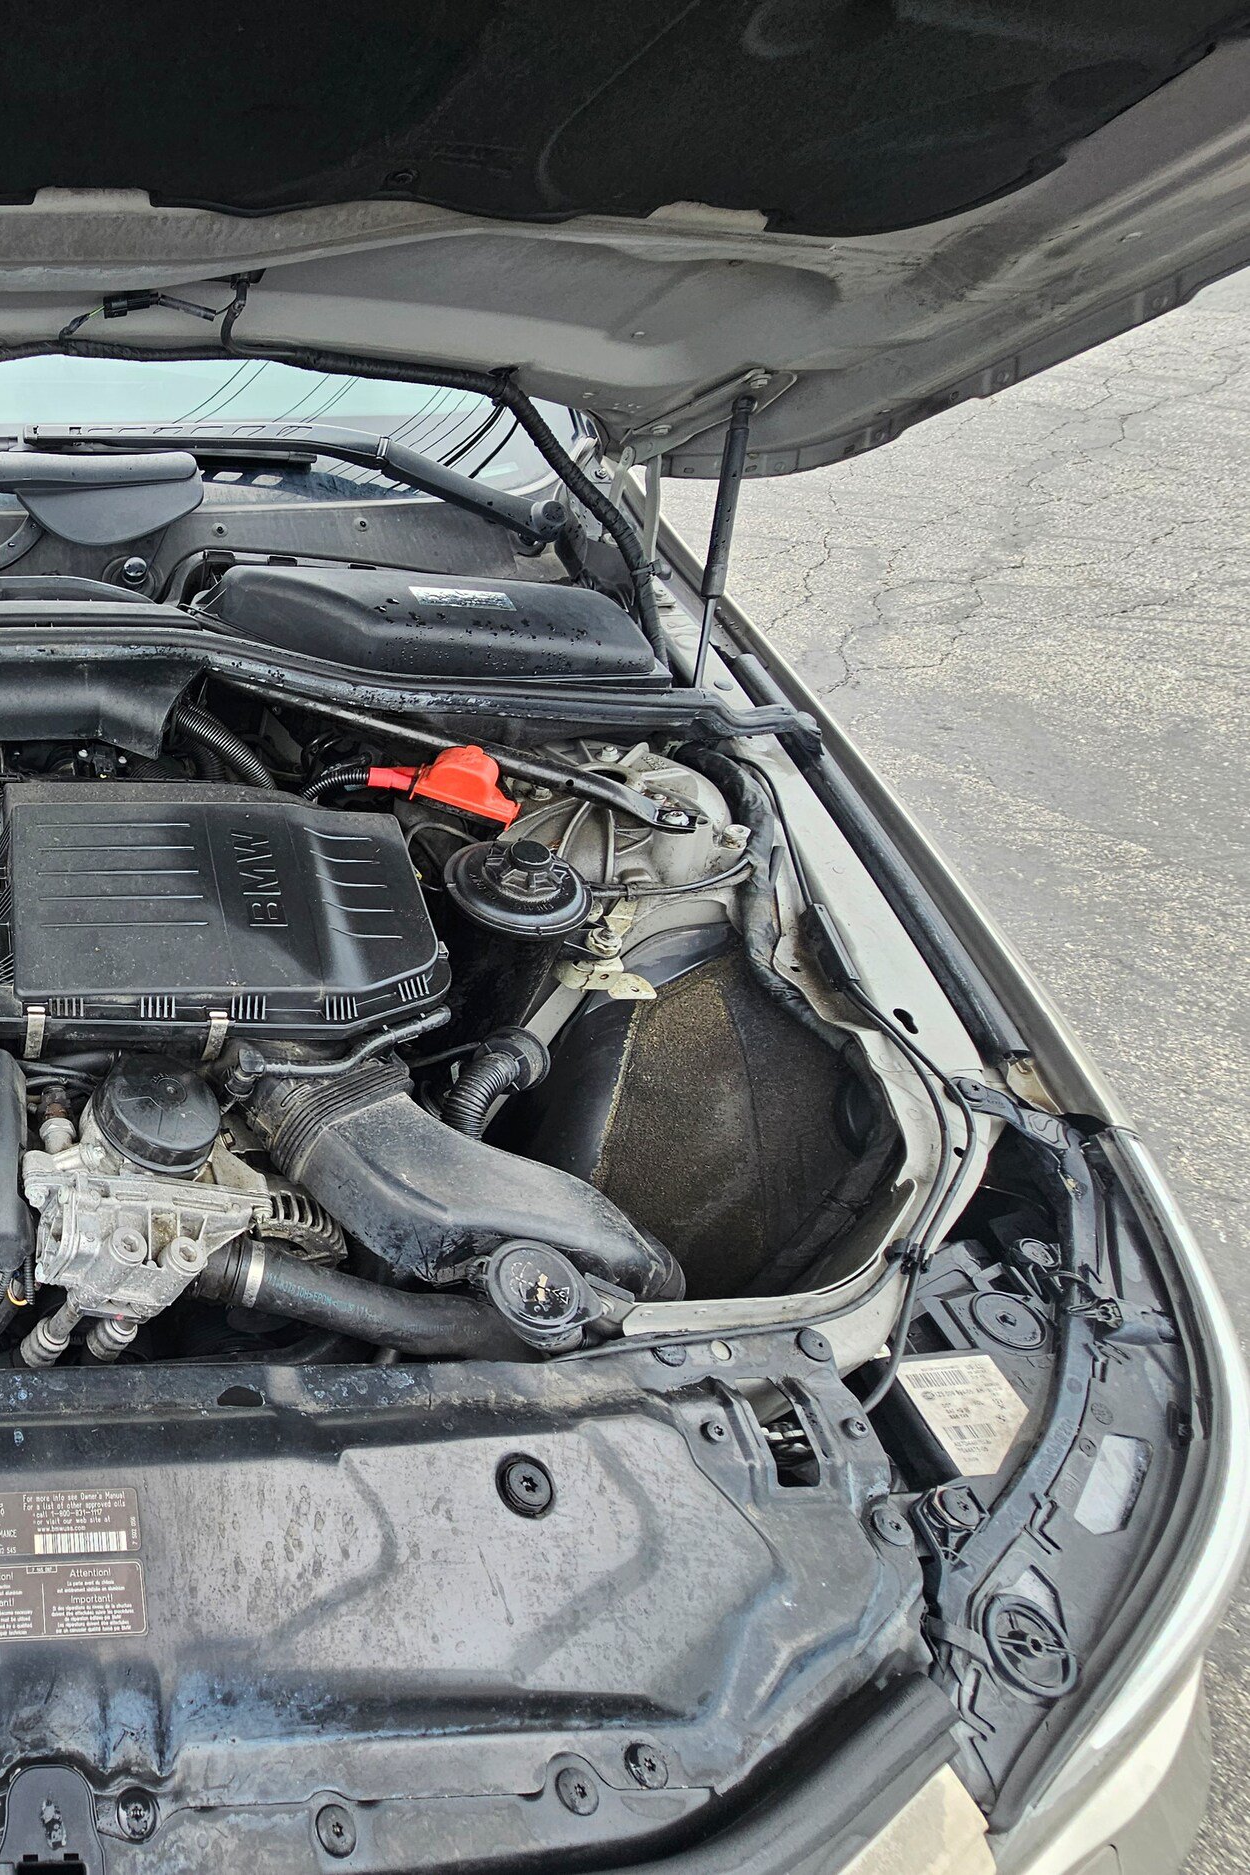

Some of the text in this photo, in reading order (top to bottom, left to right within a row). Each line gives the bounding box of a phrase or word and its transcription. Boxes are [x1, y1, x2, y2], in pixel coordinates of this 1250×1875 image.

[231, 829, 288, 927] BMW
[53, 1493, 64, 1501] info
[105, 1491, 125, 1499] Manual
[23, 1503, 33, 1511] For
[67, 1501, 82, 1509] other
[86, 1500, 111, 1509] approved
[70, 1568, 110, 1578] Attention!
[71, 1594, 113, 1604] Important!
